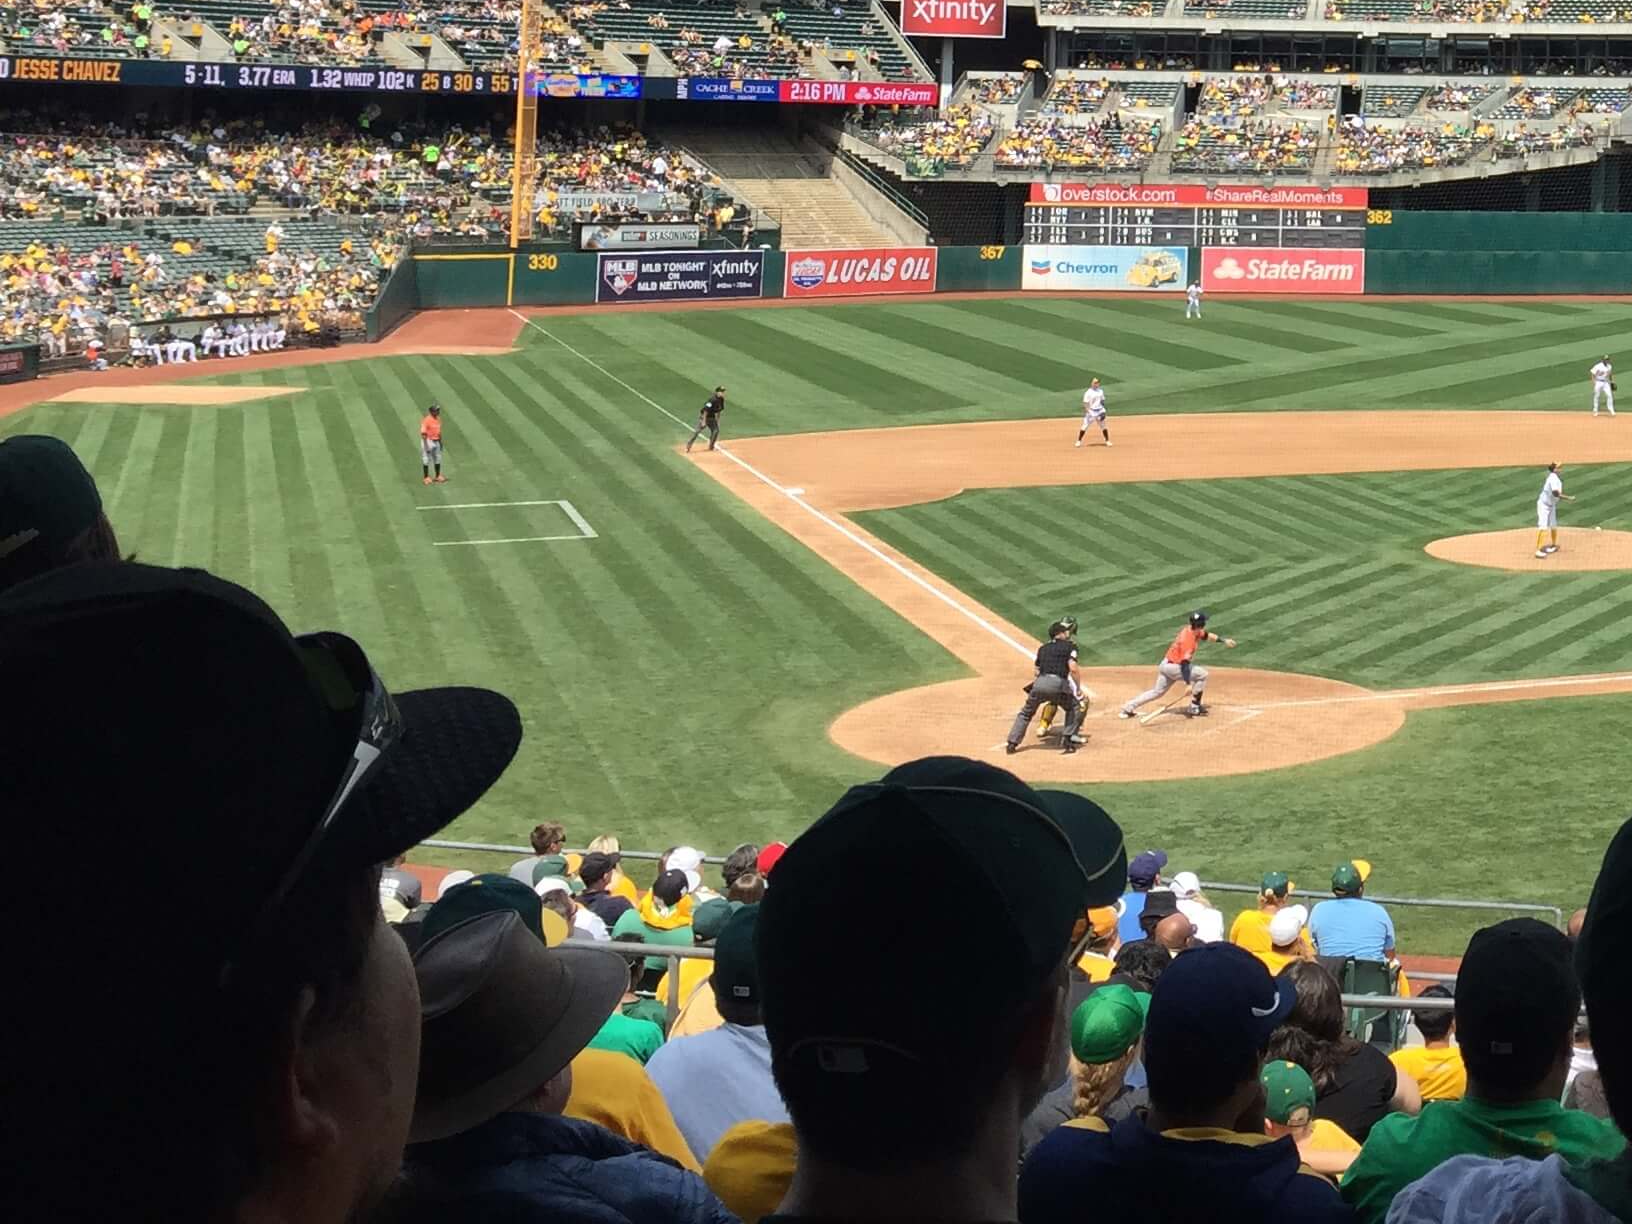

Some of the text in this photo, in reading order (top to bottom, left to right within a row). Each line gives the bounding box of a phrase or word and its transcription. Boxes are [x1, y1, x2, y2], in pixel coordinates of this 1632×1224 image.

[12, 58, 59, 80] JESSE
[63, 60, 121, 82] CHAVEZ
[239, 66, 270, 86] 3.77
[273, 69, 295, 86] ERA
[311, 68, 341, 89] 1.32
[344, 72, 374, 88] WHIP
[377, 71, 404, 90] 102
[406, 74, 415, 89] K
[421, 73, 439, 90] 25
[443, 76, 451, 89] B
[454, 73, 473, 92] 30
[475, 77, 483, 90] S
[491, 75, 510, 92] 55
[791, 83, 820, 101] 2:16
[823, 83, 846, 101] PM
[1063, 188, 1343, 204] overstock.com #ShareRealMoments
[1367, 210, 1392, 224] 362
[650, 230, 697, 241] SEASONINGS
[529, 254, 557, 271] 330
[641, 261, 705, 273] MLB TONIGHT
[712, 260, 759, 278] xfinity
[825, 257, 897, 283] LUCAS
[900, 256, 931, 281] OIL
[1056, 260, 1118, 276] Chevron
[637, 282, 658, 292] MLB
[659, 280, 708, 291] NETWORK
